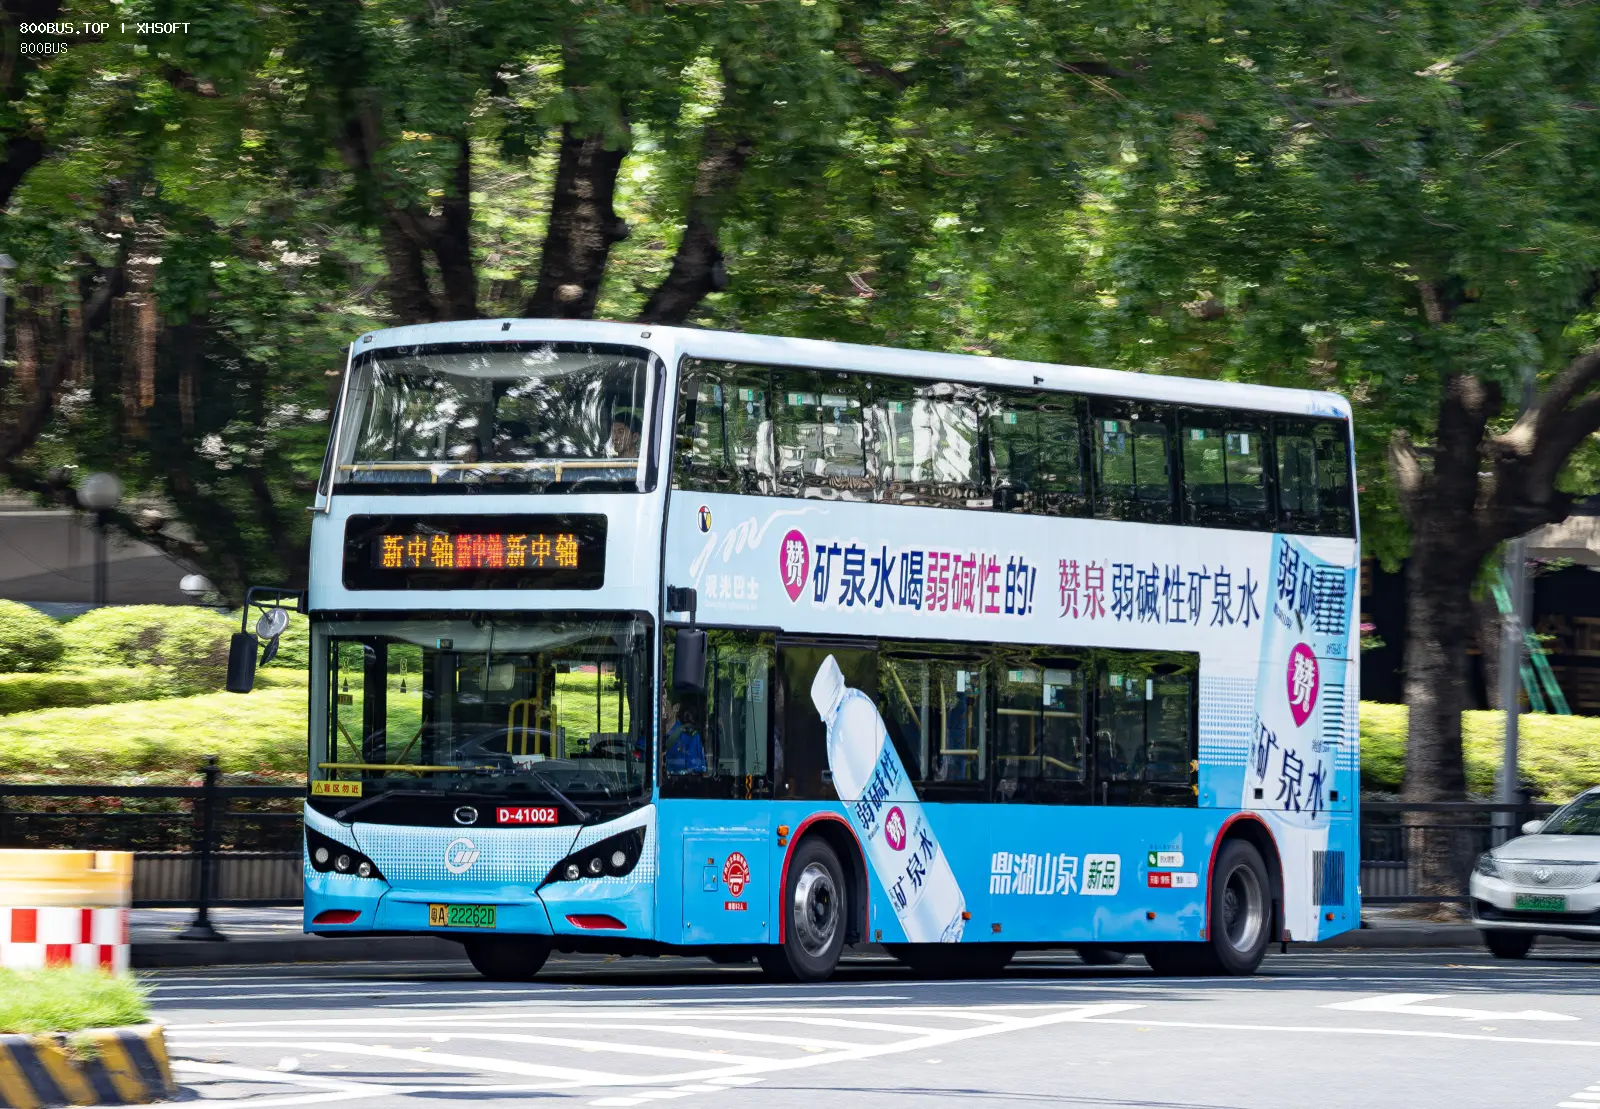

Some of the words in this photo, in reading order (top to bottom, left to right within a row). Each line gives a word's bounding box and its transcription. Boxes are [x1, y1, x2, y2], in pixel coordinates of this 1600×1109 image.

[499, 809, 555, 822] D-41002
[989, 852, 1079, 895] 鼎湖山泉
[1087, 859, 1117, 890] 新品
